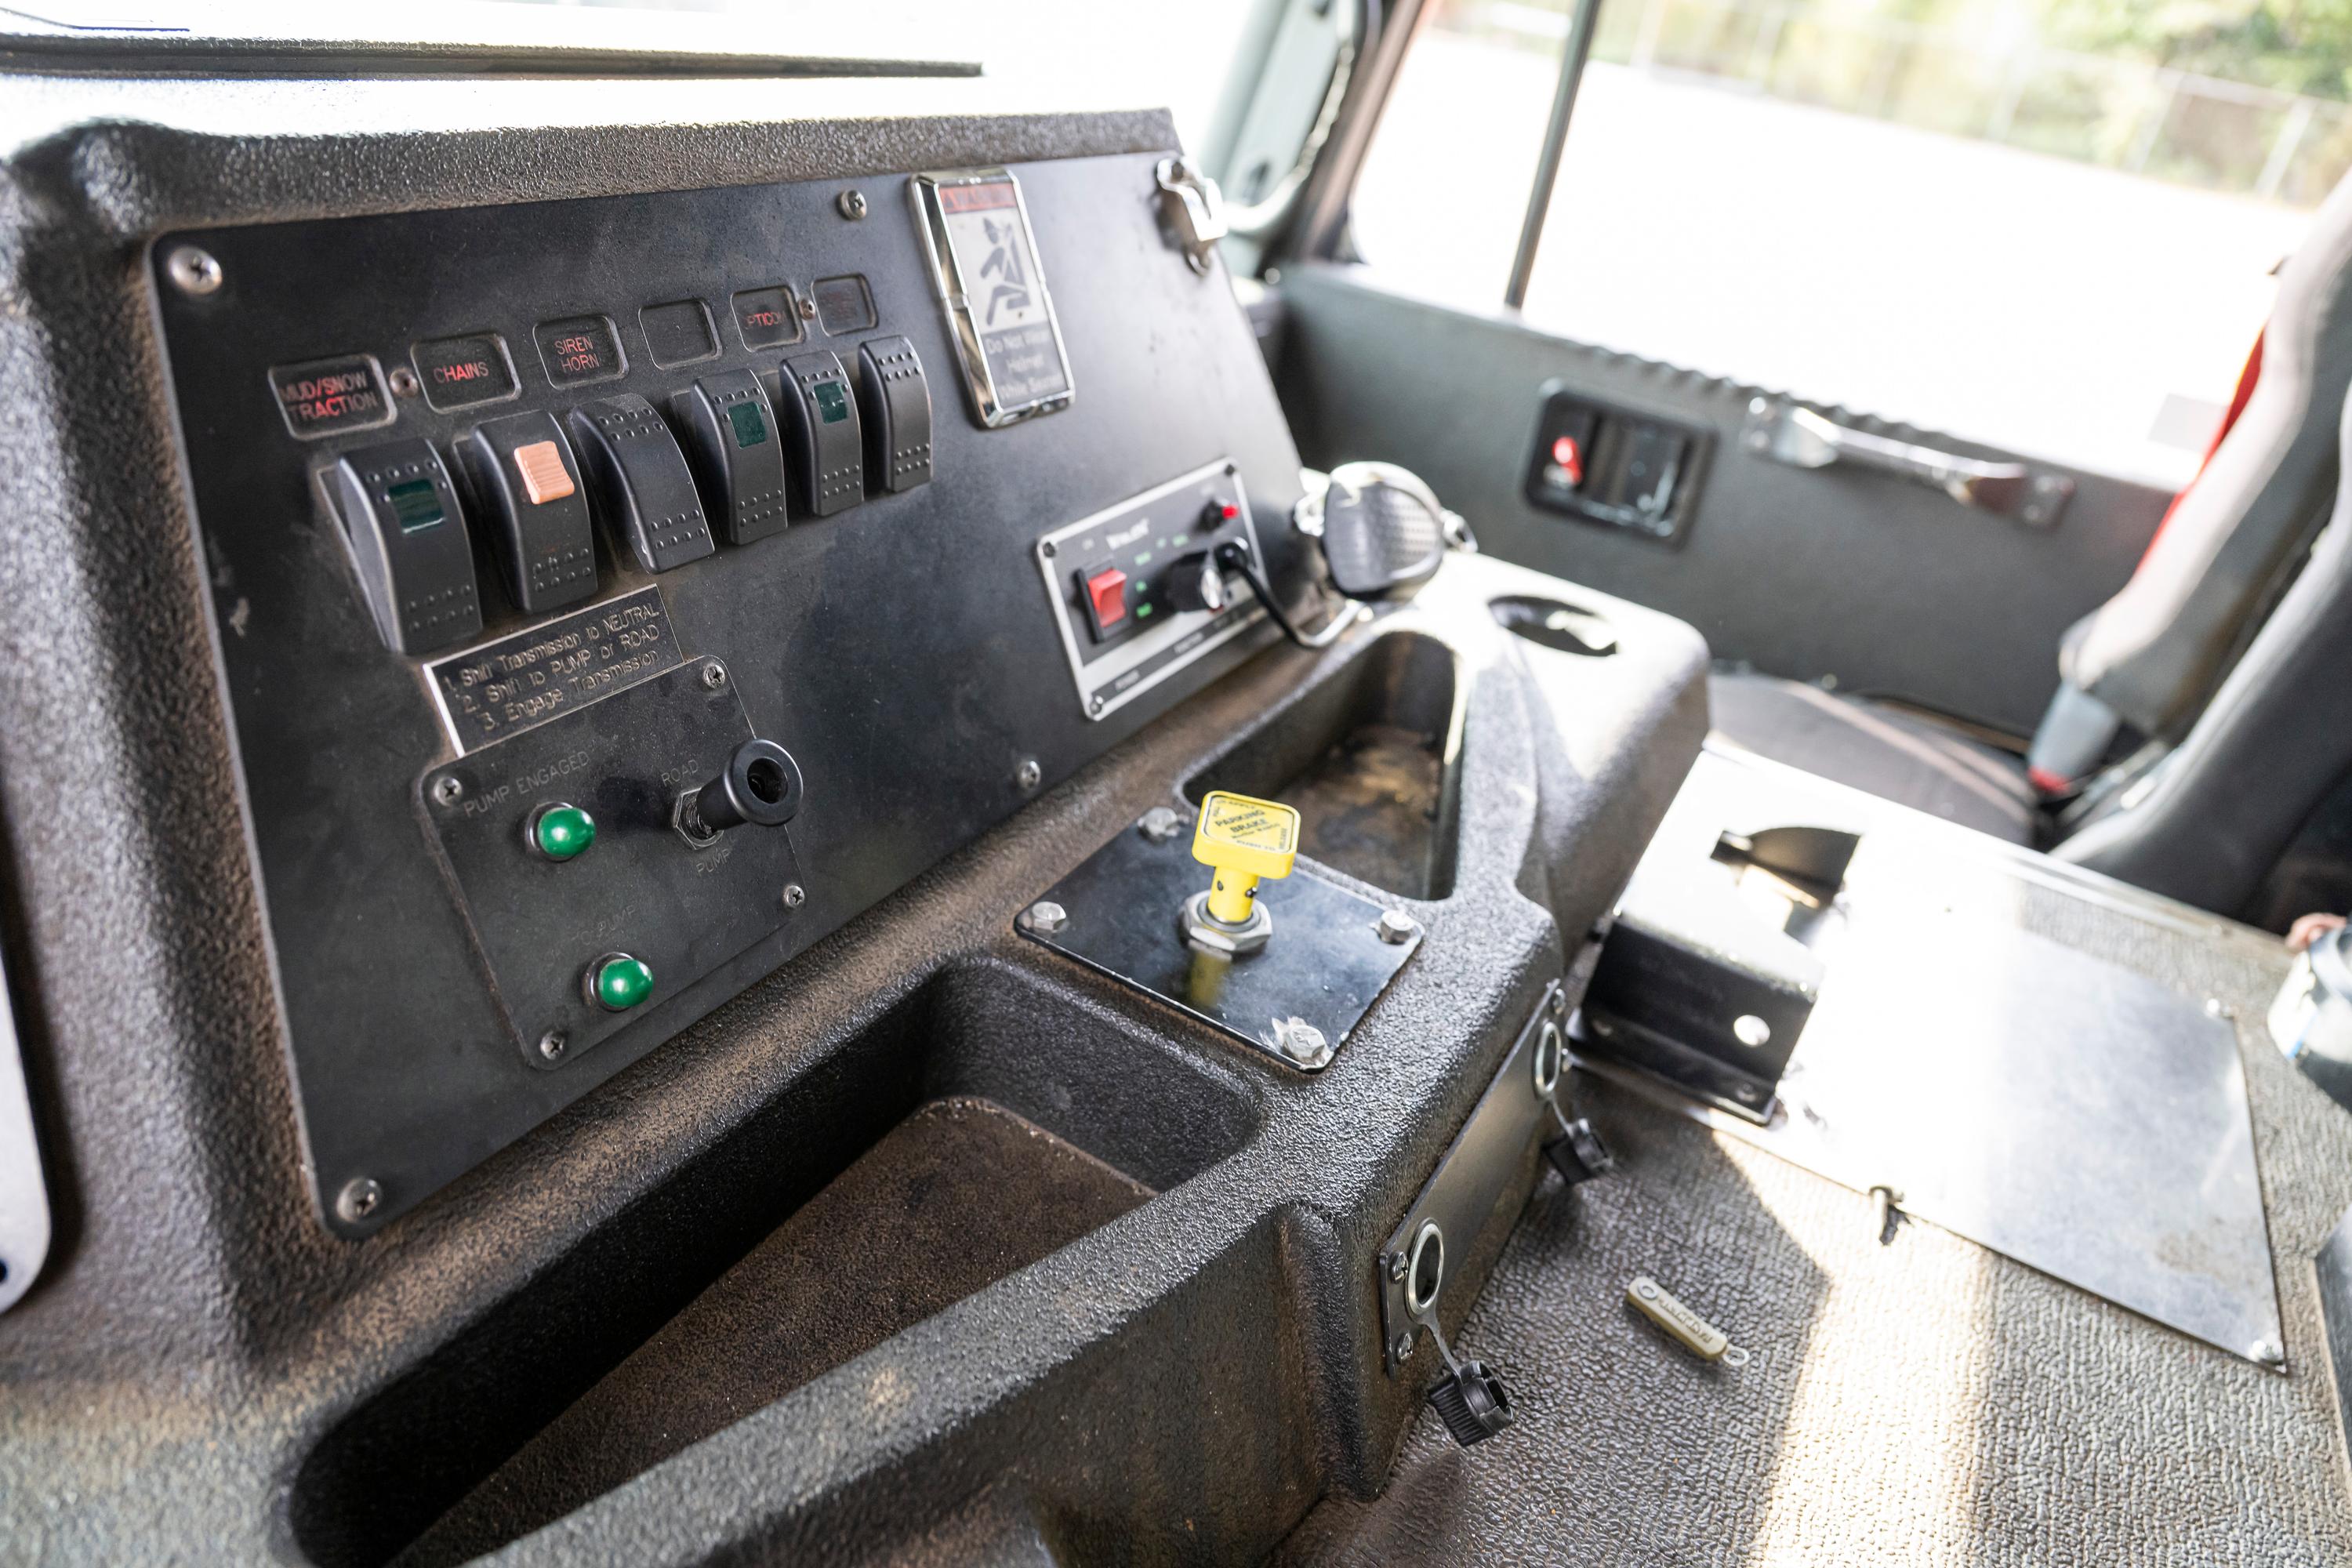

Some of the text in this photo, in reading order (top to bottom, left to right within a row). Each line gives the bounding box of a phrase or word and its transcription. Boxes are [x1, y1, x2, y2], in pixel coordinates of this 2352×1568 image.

[554, 336, 593, 354] SIREN
[434, 361, 489, 383] CHAINS
[561, 353, 600, 373] HORN
[280, 371, 367, 401] MUD/SNOW
[289, 392, 378, 422] TRACTION
[459, 663, 493, 687] Shift
[495, 633, 582, 672] Transmission
[602, 603, 660, 636] NEUTRAL
[486, 679, 522, 702] Shift
[551, 649, 591, 675] PUMP
[601, 643, 614, 660] or
[619, 624, 660, 652] ROAD
[477, 650, 659, 731] 3. Engage Transmission
[464, 750, 589, 817] PUMP ENGAGED
[661, 759, 699, 787] ROAD
[695, 848, 731, 877] PUMP
